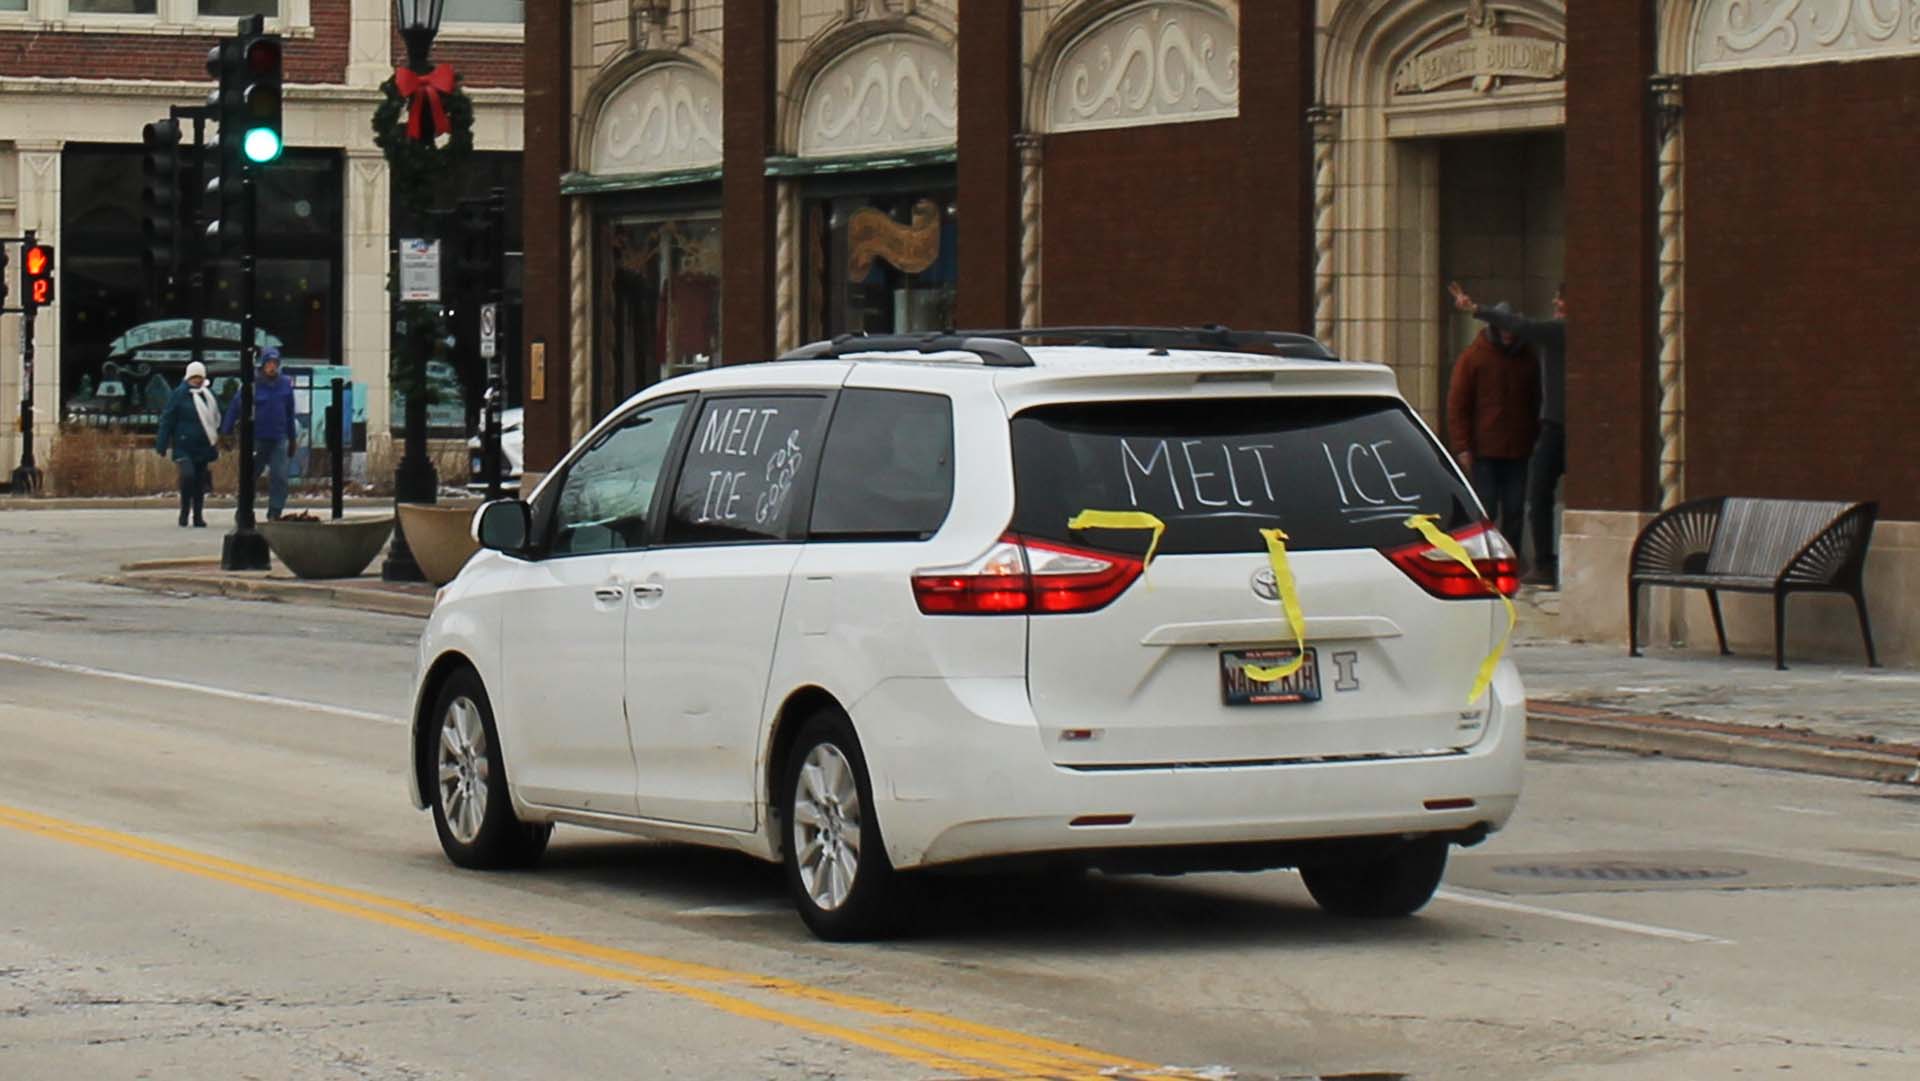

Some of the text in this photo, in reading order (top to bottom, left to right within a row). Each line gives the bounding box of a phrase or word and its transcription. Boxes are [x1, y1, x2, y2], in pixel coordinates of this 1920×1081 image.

[699, 407, 779, 456] MELT
[765, 428, 801, 482] FOR
[698, 470, 747, 523] ICE
[1120, 437, 1422, 511] MELT ICE
